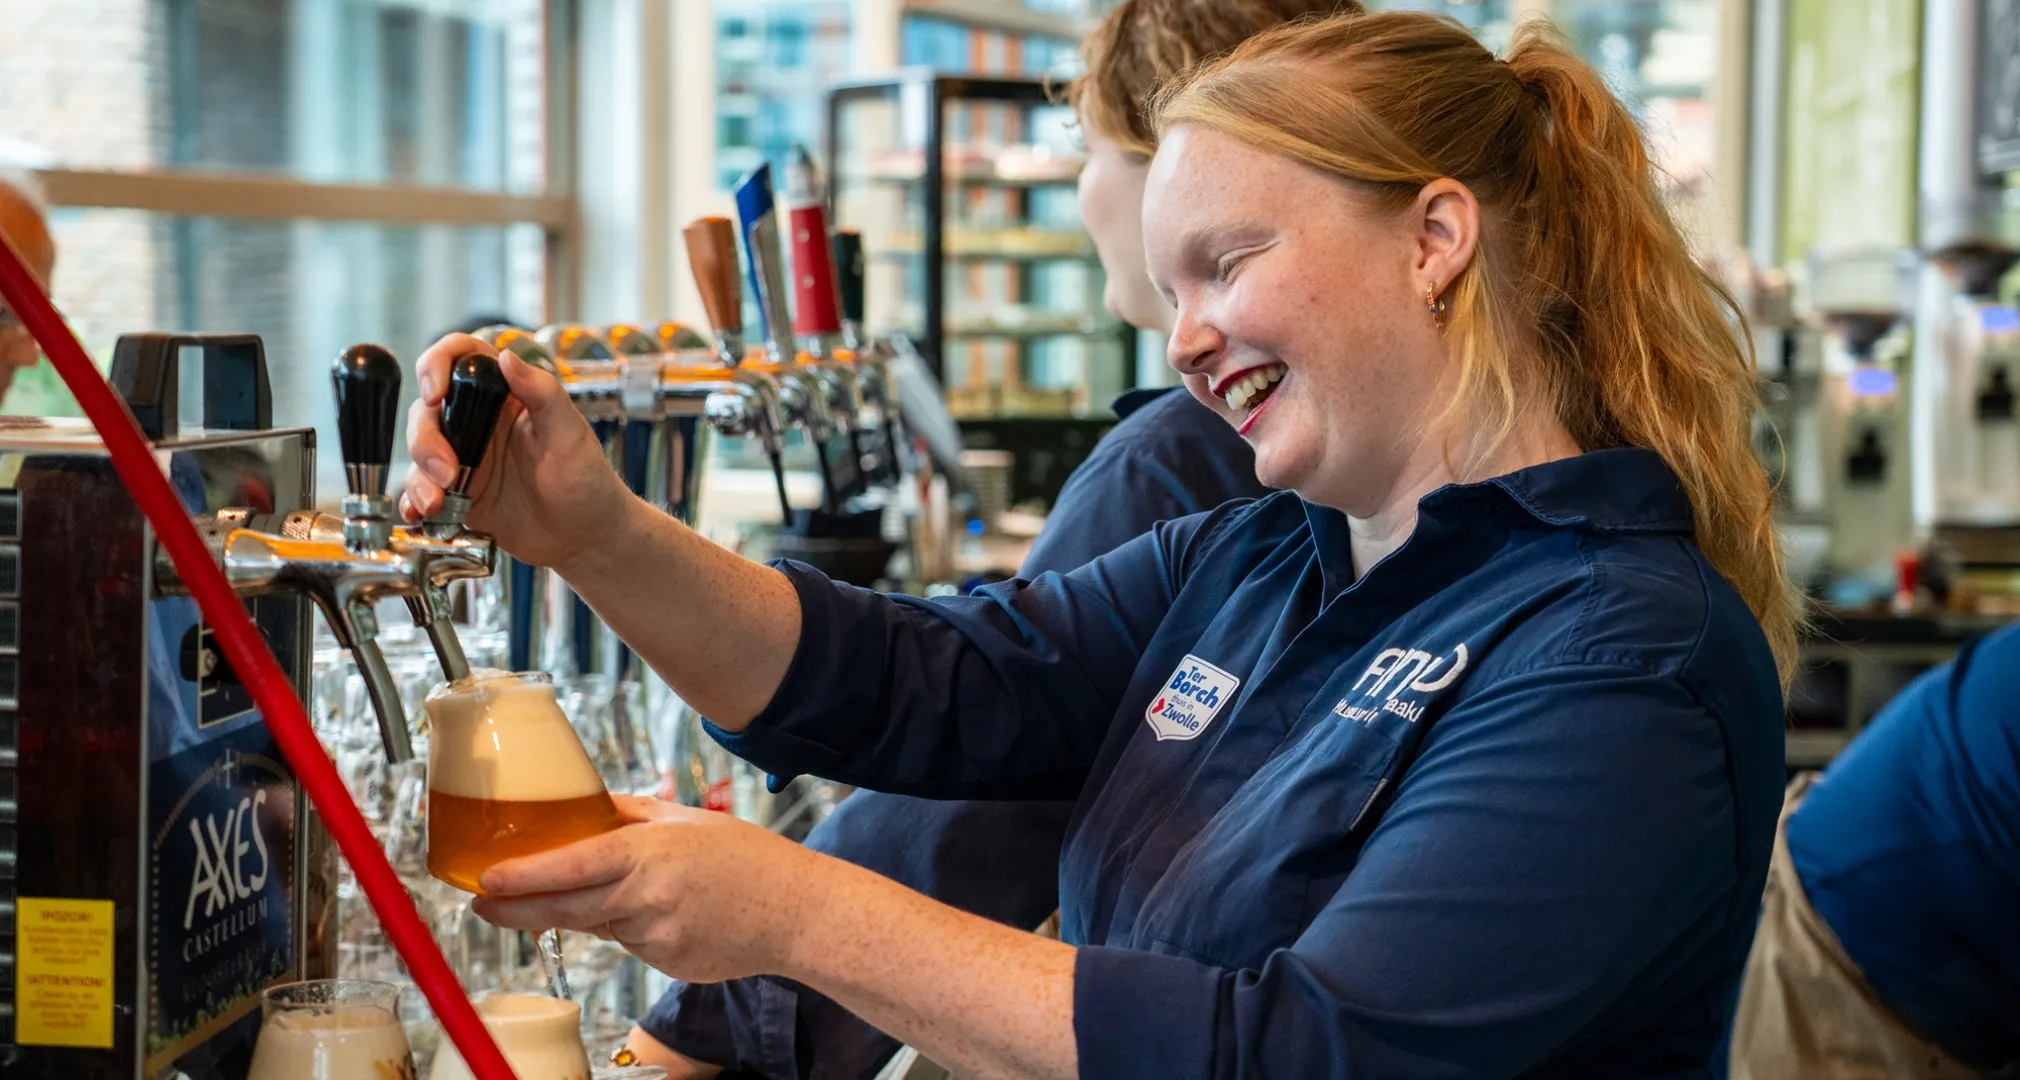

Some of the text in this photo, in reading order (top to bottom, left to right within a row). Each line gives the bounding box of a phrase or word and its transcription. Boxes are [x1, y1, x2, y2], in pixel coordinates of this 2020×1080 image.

[1187, 665, 1207, 684] Ter
[1169, 670, 1219, 709] Borch
[1170, 694, 1195, 711] thuis in
[1161, 703, 1199, 731] Zwolle
[184, 788, 268, 930] AXES
